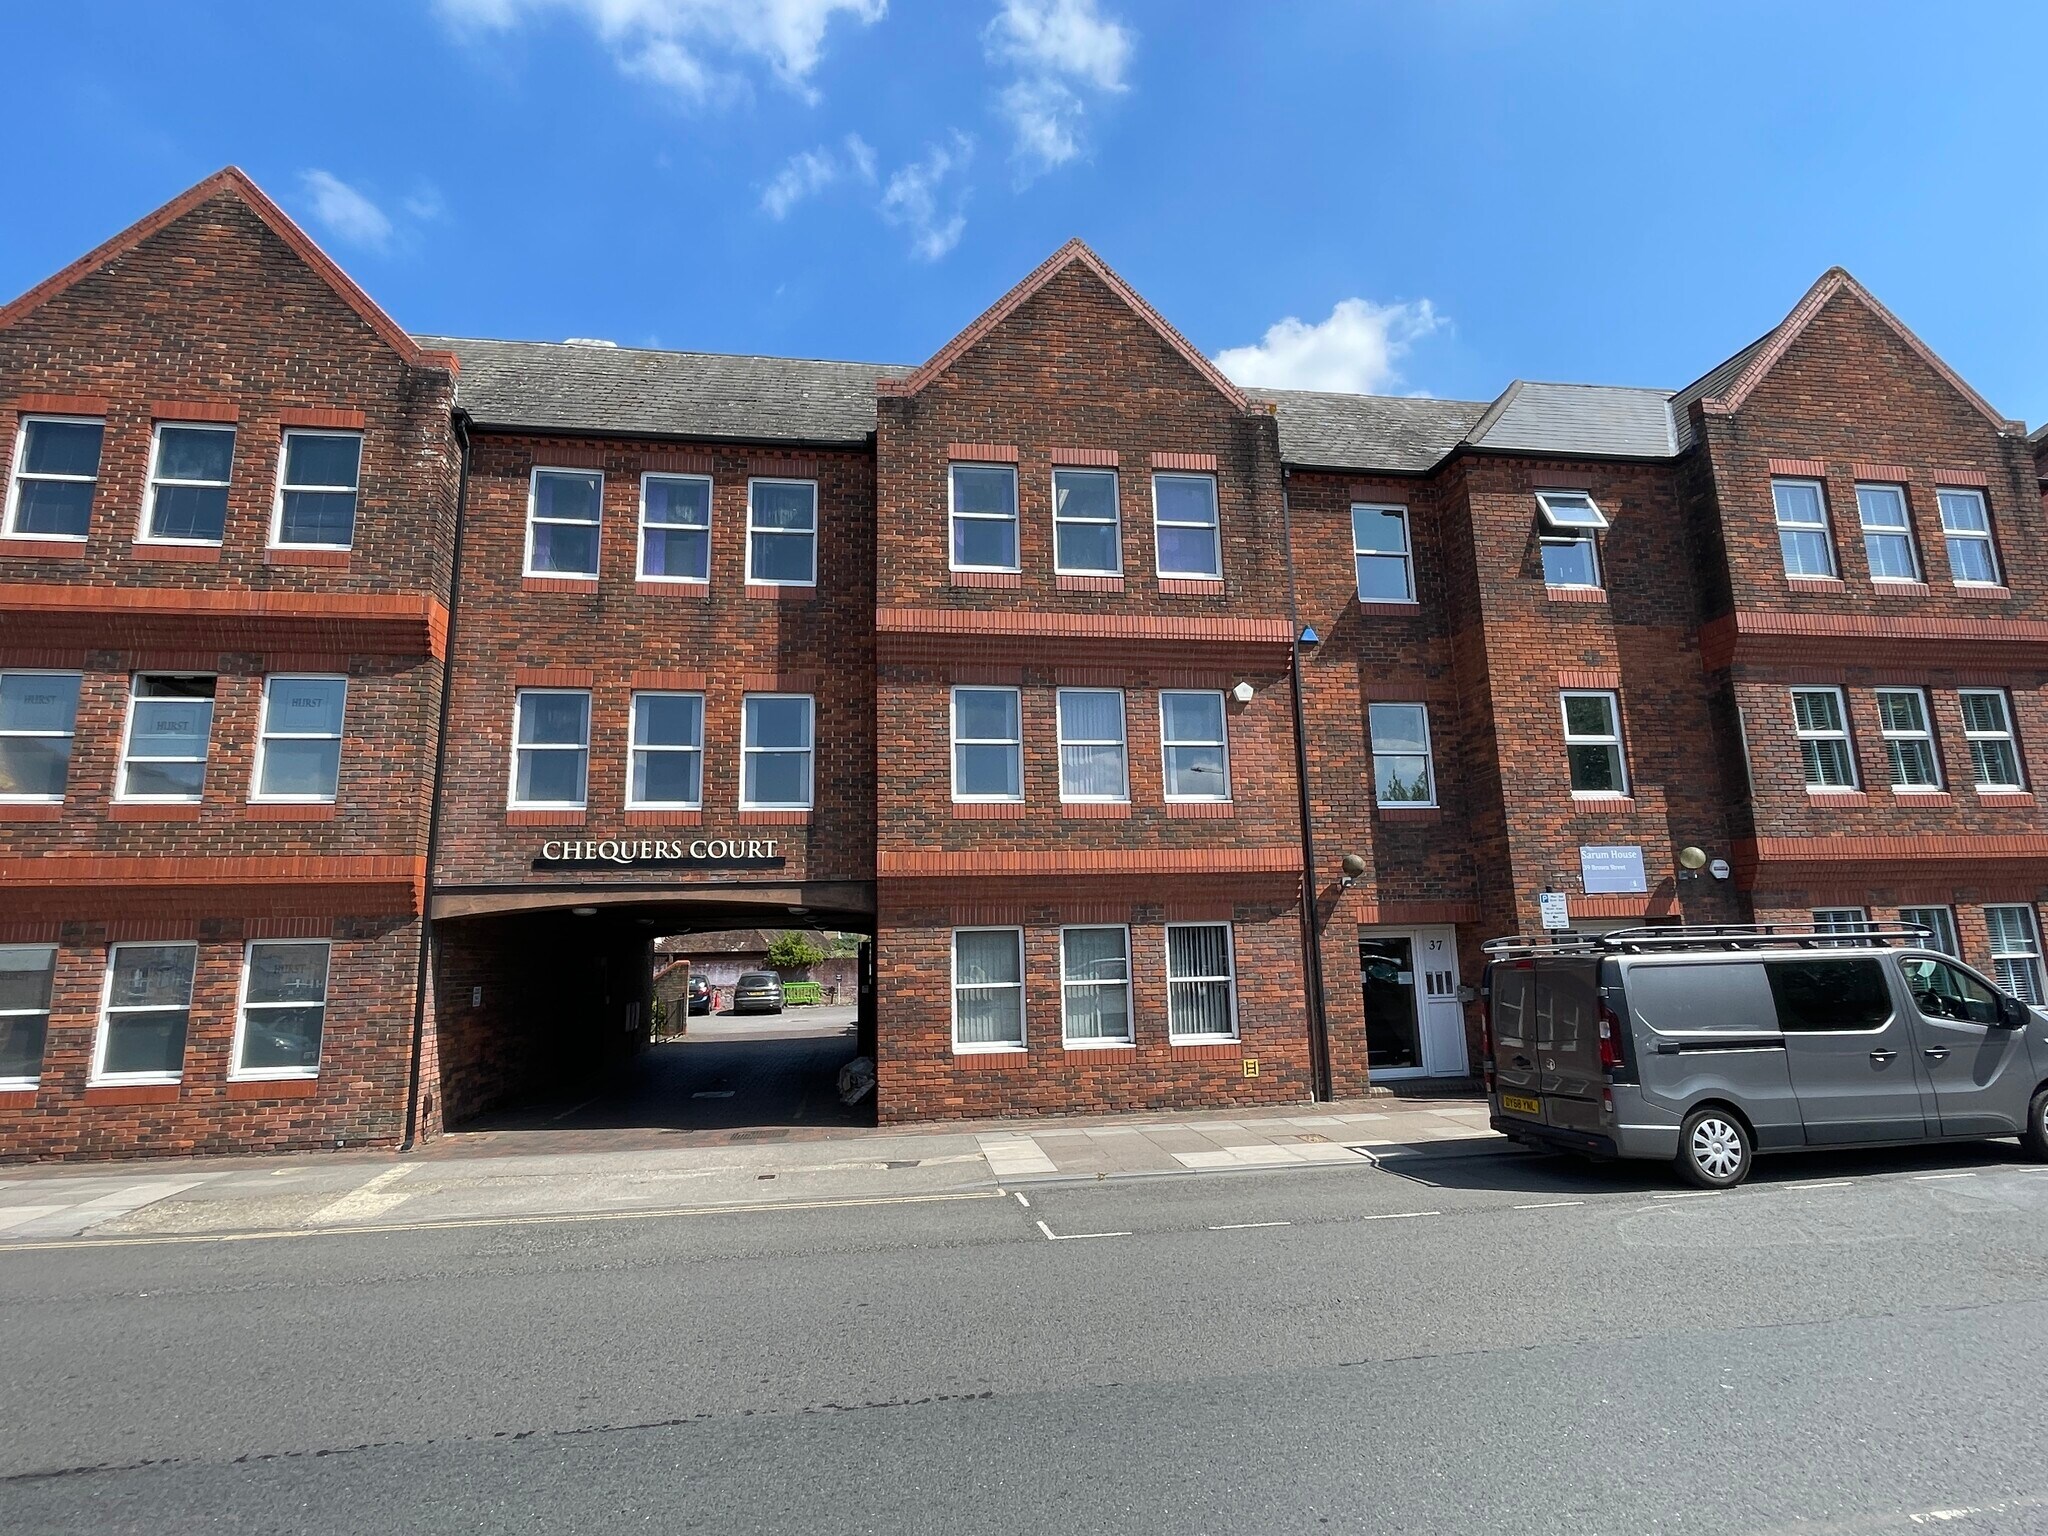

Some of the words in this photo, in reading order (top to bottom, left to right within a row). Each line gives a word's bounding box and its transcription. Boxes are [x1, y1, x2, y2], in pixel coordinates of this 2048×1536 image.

[291, 698, 323, 708] HURST
[157, 721, 189, 731] HURST
[542, 840, 682, 864] CHEQUERS
[689, 840, 778, 859] COURT
[1581, 850, 1609, 859] Sarum
[1611, 850, 1637, 859] House
[1429, 940, 1442, 951] 37
